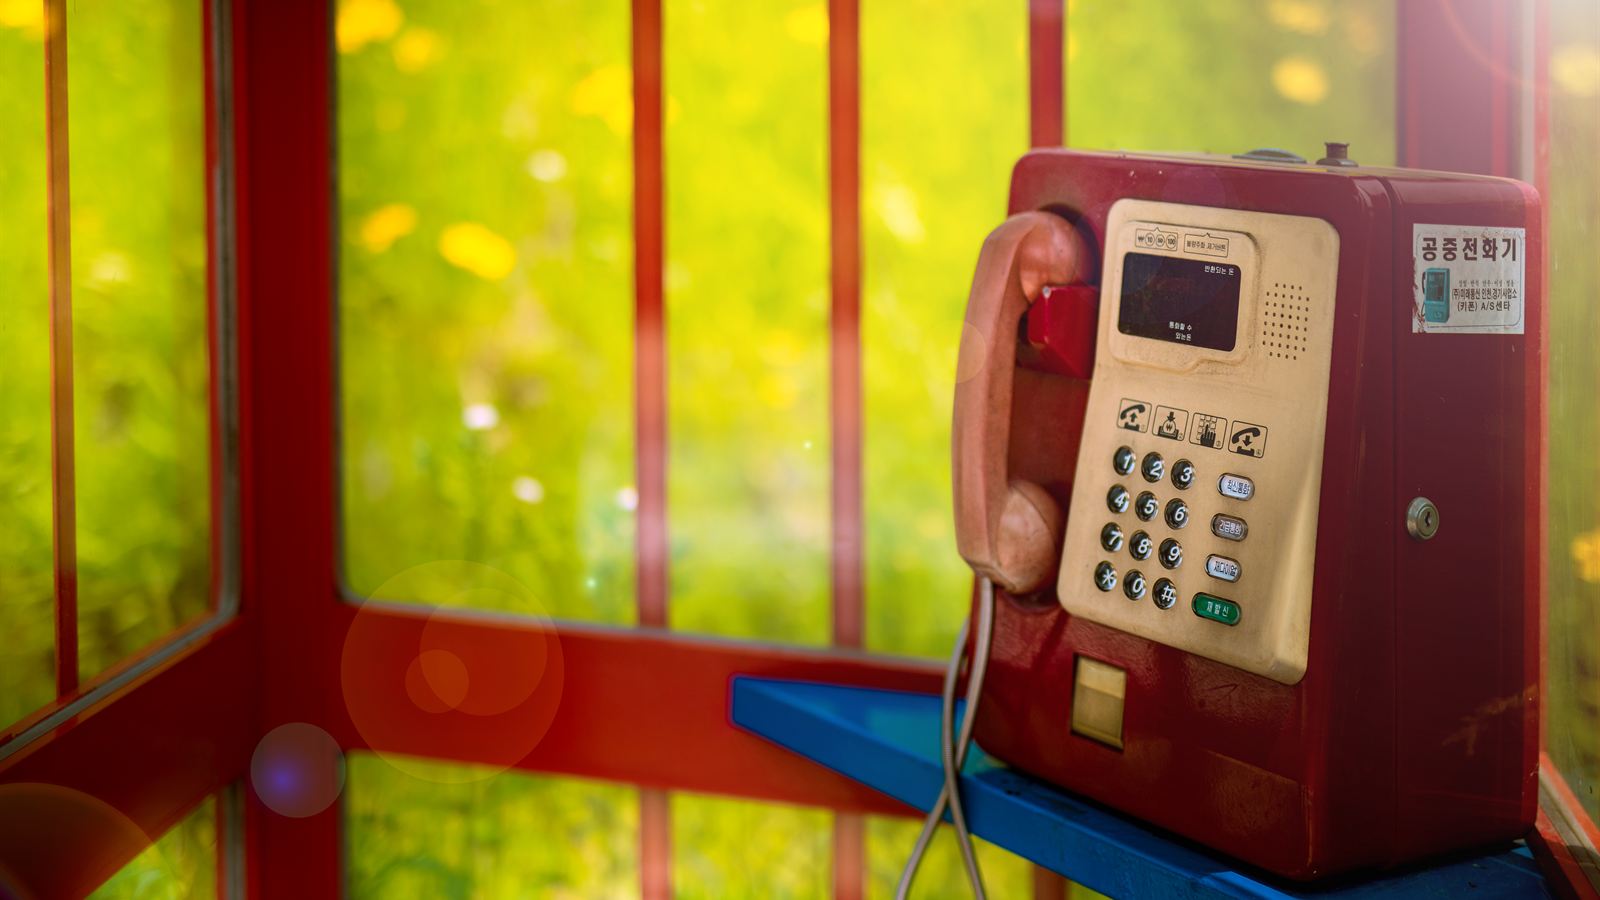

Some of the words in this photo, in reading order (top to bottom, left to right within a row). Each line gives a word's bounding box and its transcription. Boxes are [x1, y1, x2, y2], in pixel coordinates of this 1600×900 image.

[1167, 238, 1176, 246] 100
[1422, 238, 1516, 261] 공중전화기
[1457, 301, 1478, 312] (키폰)
[1122, 455, 1132, 470] 1
[1150, 461, 1162, 477] 2
[1180, 466, 1192, 482] 3
[1114, 493, 1127, 508] 4
[1144, 499, 1156, 515] 5
[1174, 506, 1187, 522] 6
[1219, 519, 1242, 535] 긴급통화
[1109, 530, 1122, 546] 7
[1137, 538, 1150, 554] 8
[1168, 546, 1181, 562] 9
[1214, 560, 1237, 577] 재다이얼
[1133, 577, 1145, 593] 0
[1161, 584, 1175, 602] #
[1206, 601, 1229, 617] 재발신
